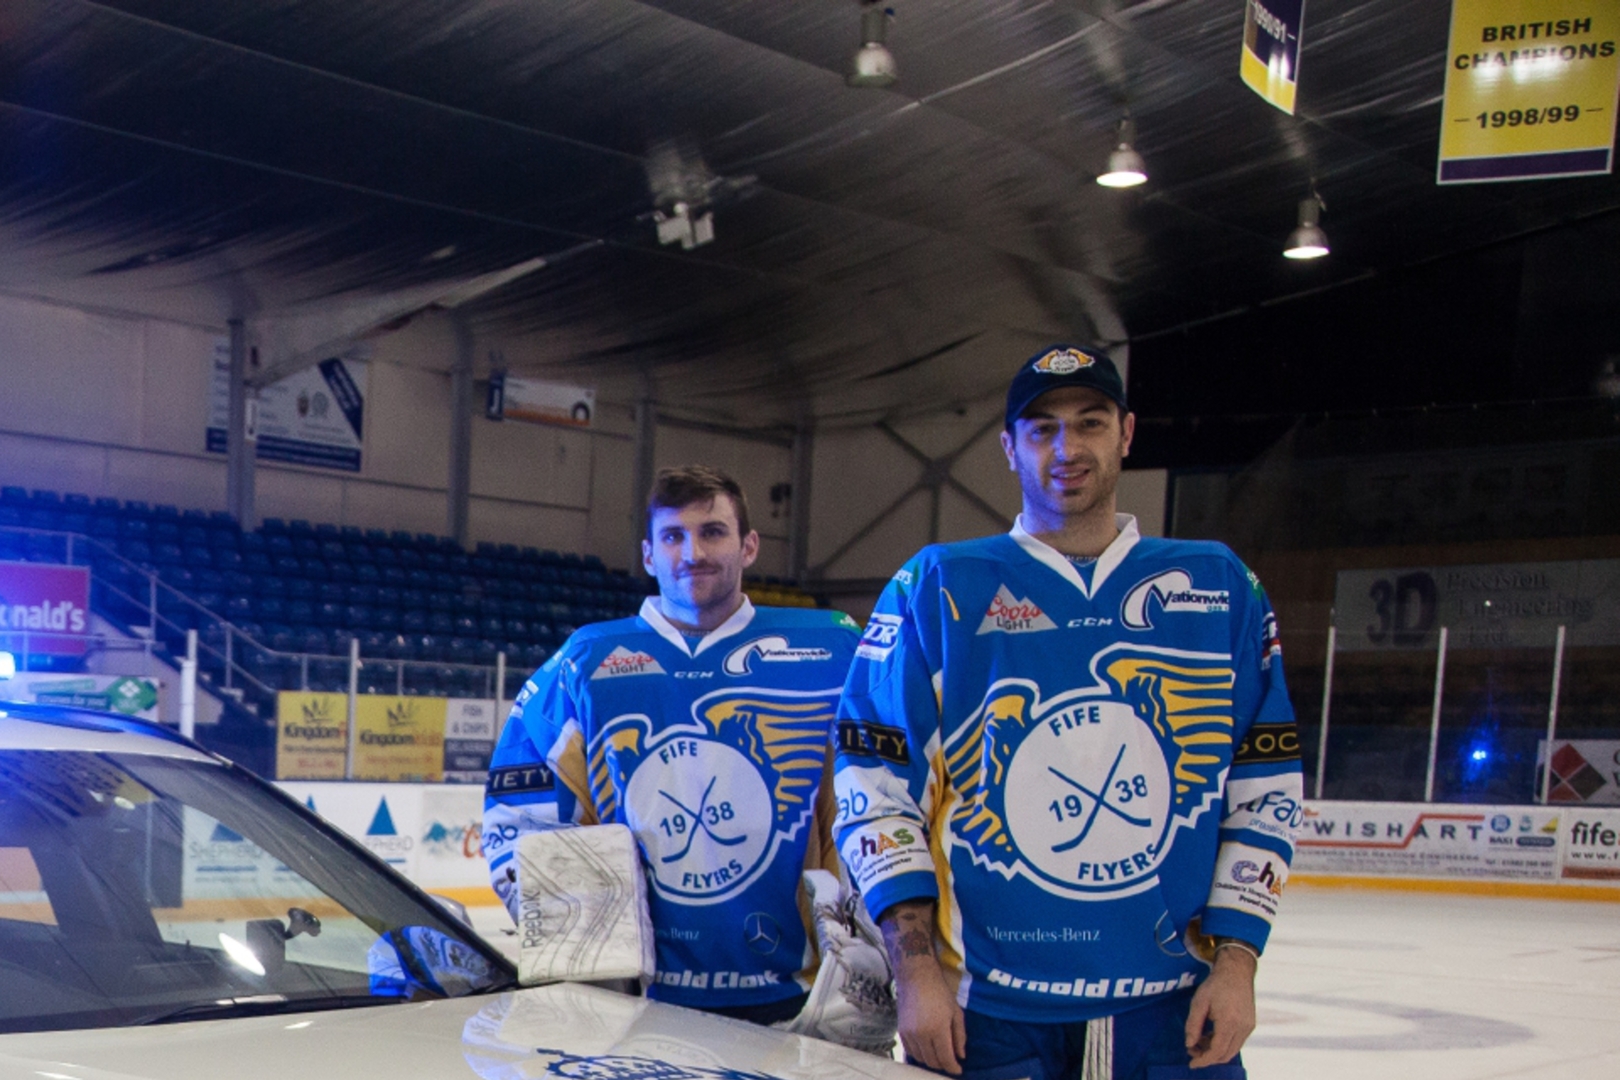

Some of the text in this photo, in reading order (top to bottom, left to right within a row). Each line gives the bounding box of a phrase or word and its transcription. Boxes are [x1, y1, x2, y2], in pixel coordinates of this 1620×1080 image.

[1482, 17, 1592, 43] BRITISH
[1454, 41, 1616, 70] CHAMPIONS
[1476, 105, 1580, 129] 1998/99
[986, 594, 1042, 620] Coors
[1367, 572, 1436, 648] 3D
[996, 615, 1033, 631] LIGHT
[1067, 617, 1113, 628] CCM
[609, 663, 646, 675] LIGHT
[674, 671, 714, 679] CCM
[1048, 705, 1101, 737] FIFE
[659, 739, 698, 765] FIFE
[846, 728, 906, 756] IETY
[492, 769, 551, 790] IETY
[1049, 773, 1148, 823] 19 38
[659, 801, 735, 838] 19 38
[1315, 819, 1484, 842] WISHART
[1571, 820, 1616, 847] fife
[682, 858, 743, 889] FLYERS
[1078, 843, 1157, 881] FLYERS
[986, 926, 1101, 943] Mercedes-Benz
[712, 970, 781, 989] Clark
[986, 968, 1198, 998] Arnold Clark
